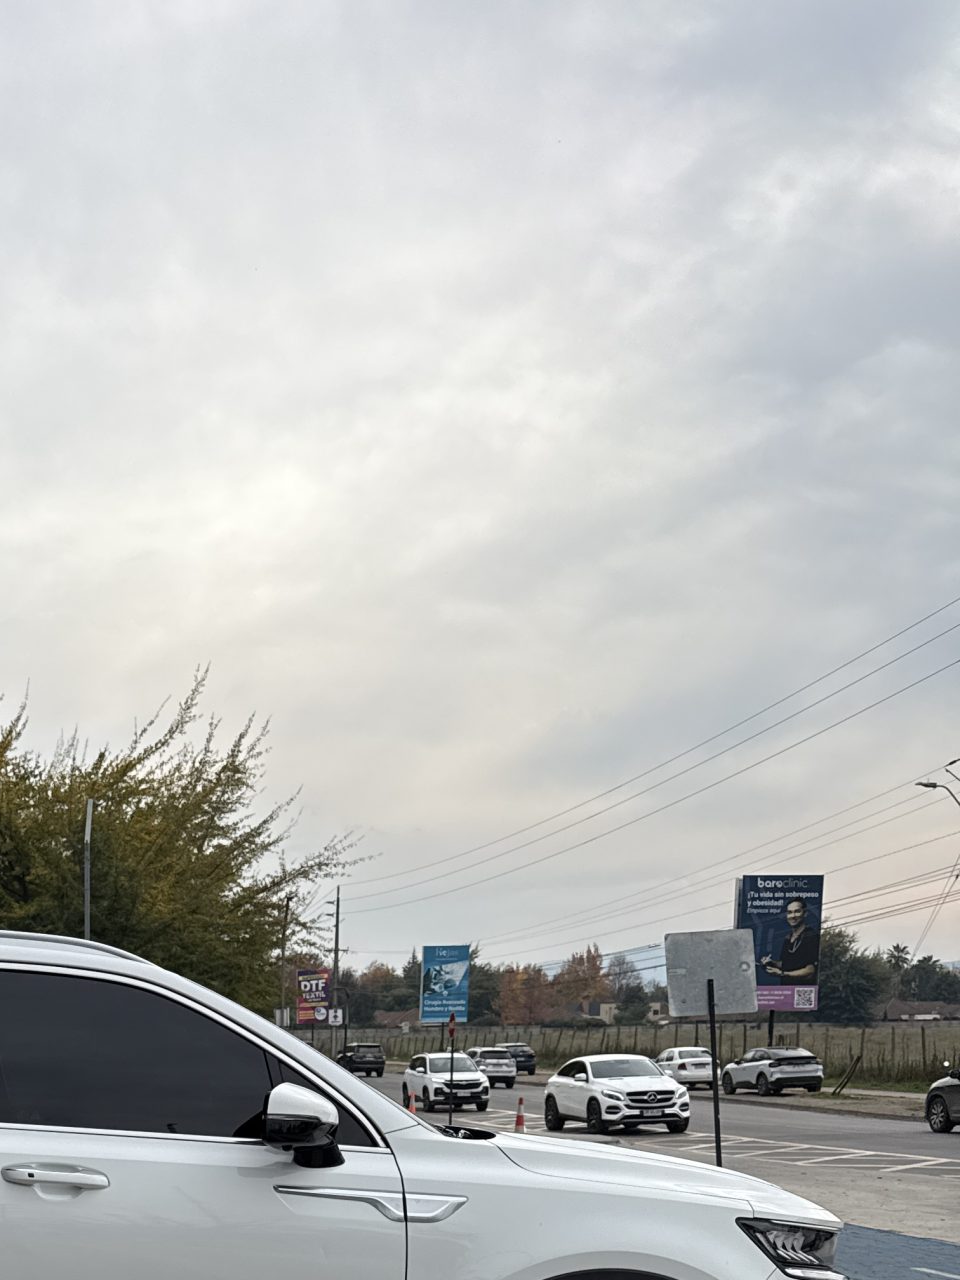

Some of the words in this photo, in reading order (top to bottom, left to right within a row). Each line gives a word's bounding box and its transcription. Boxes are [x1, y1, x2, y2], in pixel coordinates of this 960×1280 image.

[785, 891, 819, 899] sobrepeso
[300, 979, 326, 991] DTF
[302, 991, 326, 999] TEXTIL
